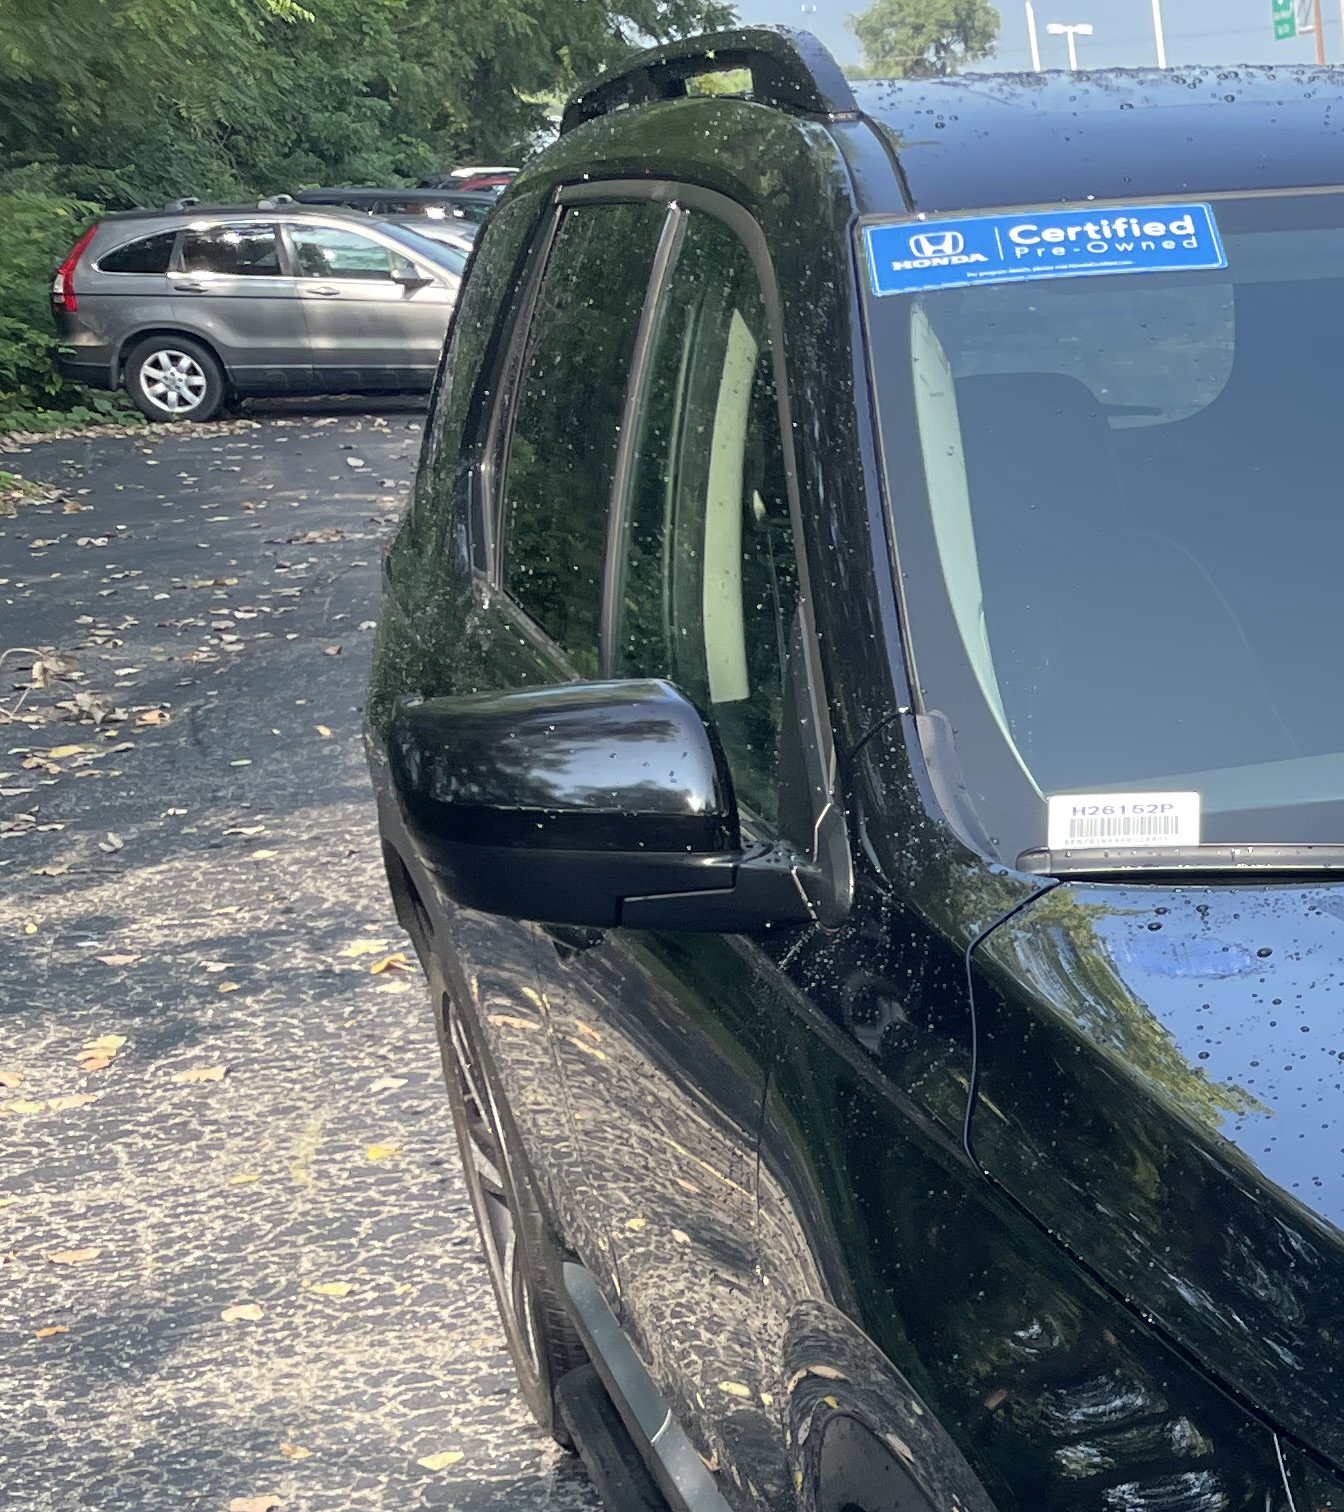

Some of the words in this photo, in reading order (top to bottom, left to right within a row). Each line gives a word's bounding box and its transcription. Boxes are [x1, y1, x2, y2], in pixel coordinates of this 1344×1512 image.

[1008, 214, 1196, 245] Certified
[1014, 235, 1198, 259] Pre-Owned
[892, 253, 989, 271] HONDA
[1072, 803, 1174, 817] H26152P
